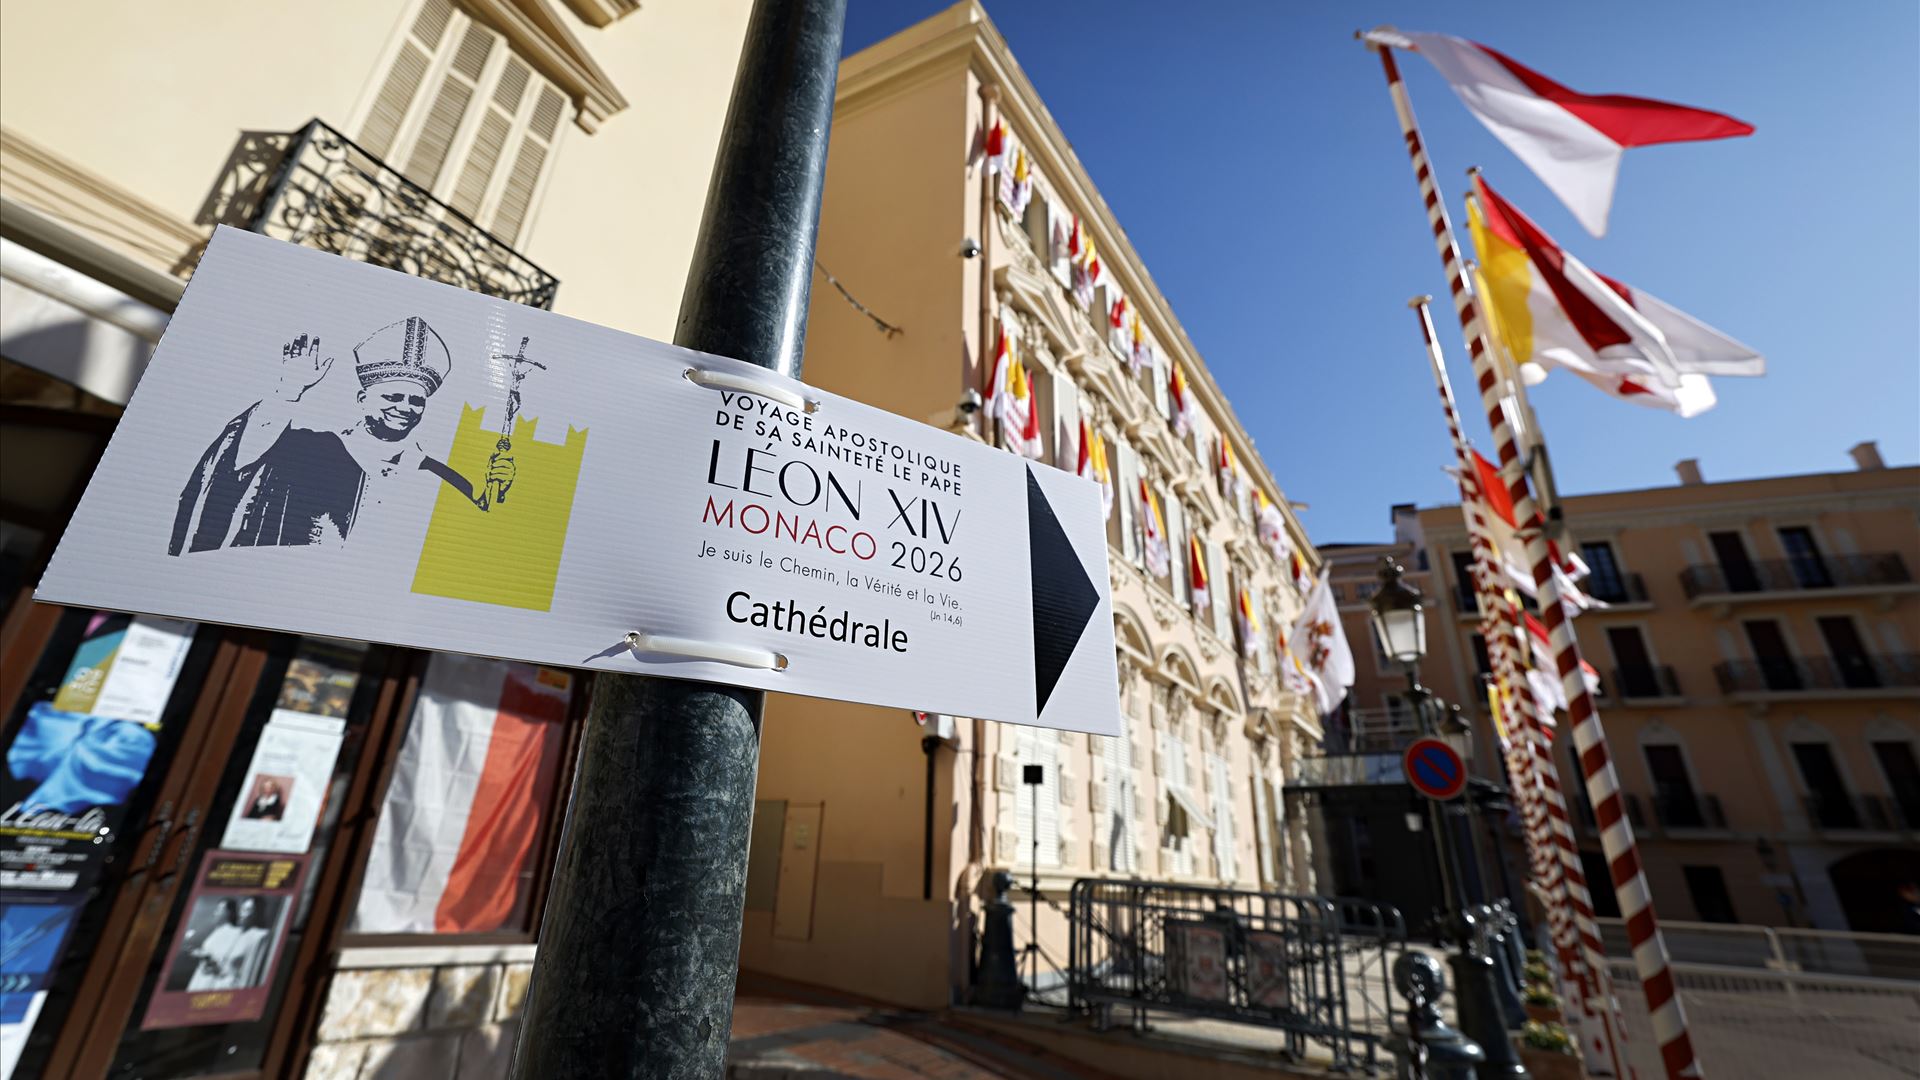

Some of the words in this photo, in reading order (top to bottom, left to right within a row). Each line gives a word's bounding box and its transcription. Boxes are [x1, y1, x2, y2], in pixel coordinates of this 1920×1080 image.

[715, 410, 745, 431] DE
[755, 420, 782, 442] SA
[791, 432, 884, 473] SAINTETÉ
[893, 463, 911, 481] LE
[921, 473, 962, 496] PAPE
[720, 390, 812, 431] VOYAGE
[823, 424, 962, 478] APOSTOLIQUE
[707, 439, 861, 521] LÉON
[887, 488, 961, 545] XIV
[698, 540, 717, 558] Je
[723, 546, 753, 565] suis
[759, 550, 773, 569] le
[780, 556, 840, 586] Chemin,
[846, 570, 858, 588] la
[865, 575, 902, 597] Vérité
[906, 588, 918, 600] et
[923, 588, 935, 604] la
[940, 592, 963, 610] Vie.
[702, 495, 876, 560] MONACO
[891, 541, 963, 582] 2026
[726, 591, 908, 652] Cathédrale
[930, 610, 941, 621] (Jn
